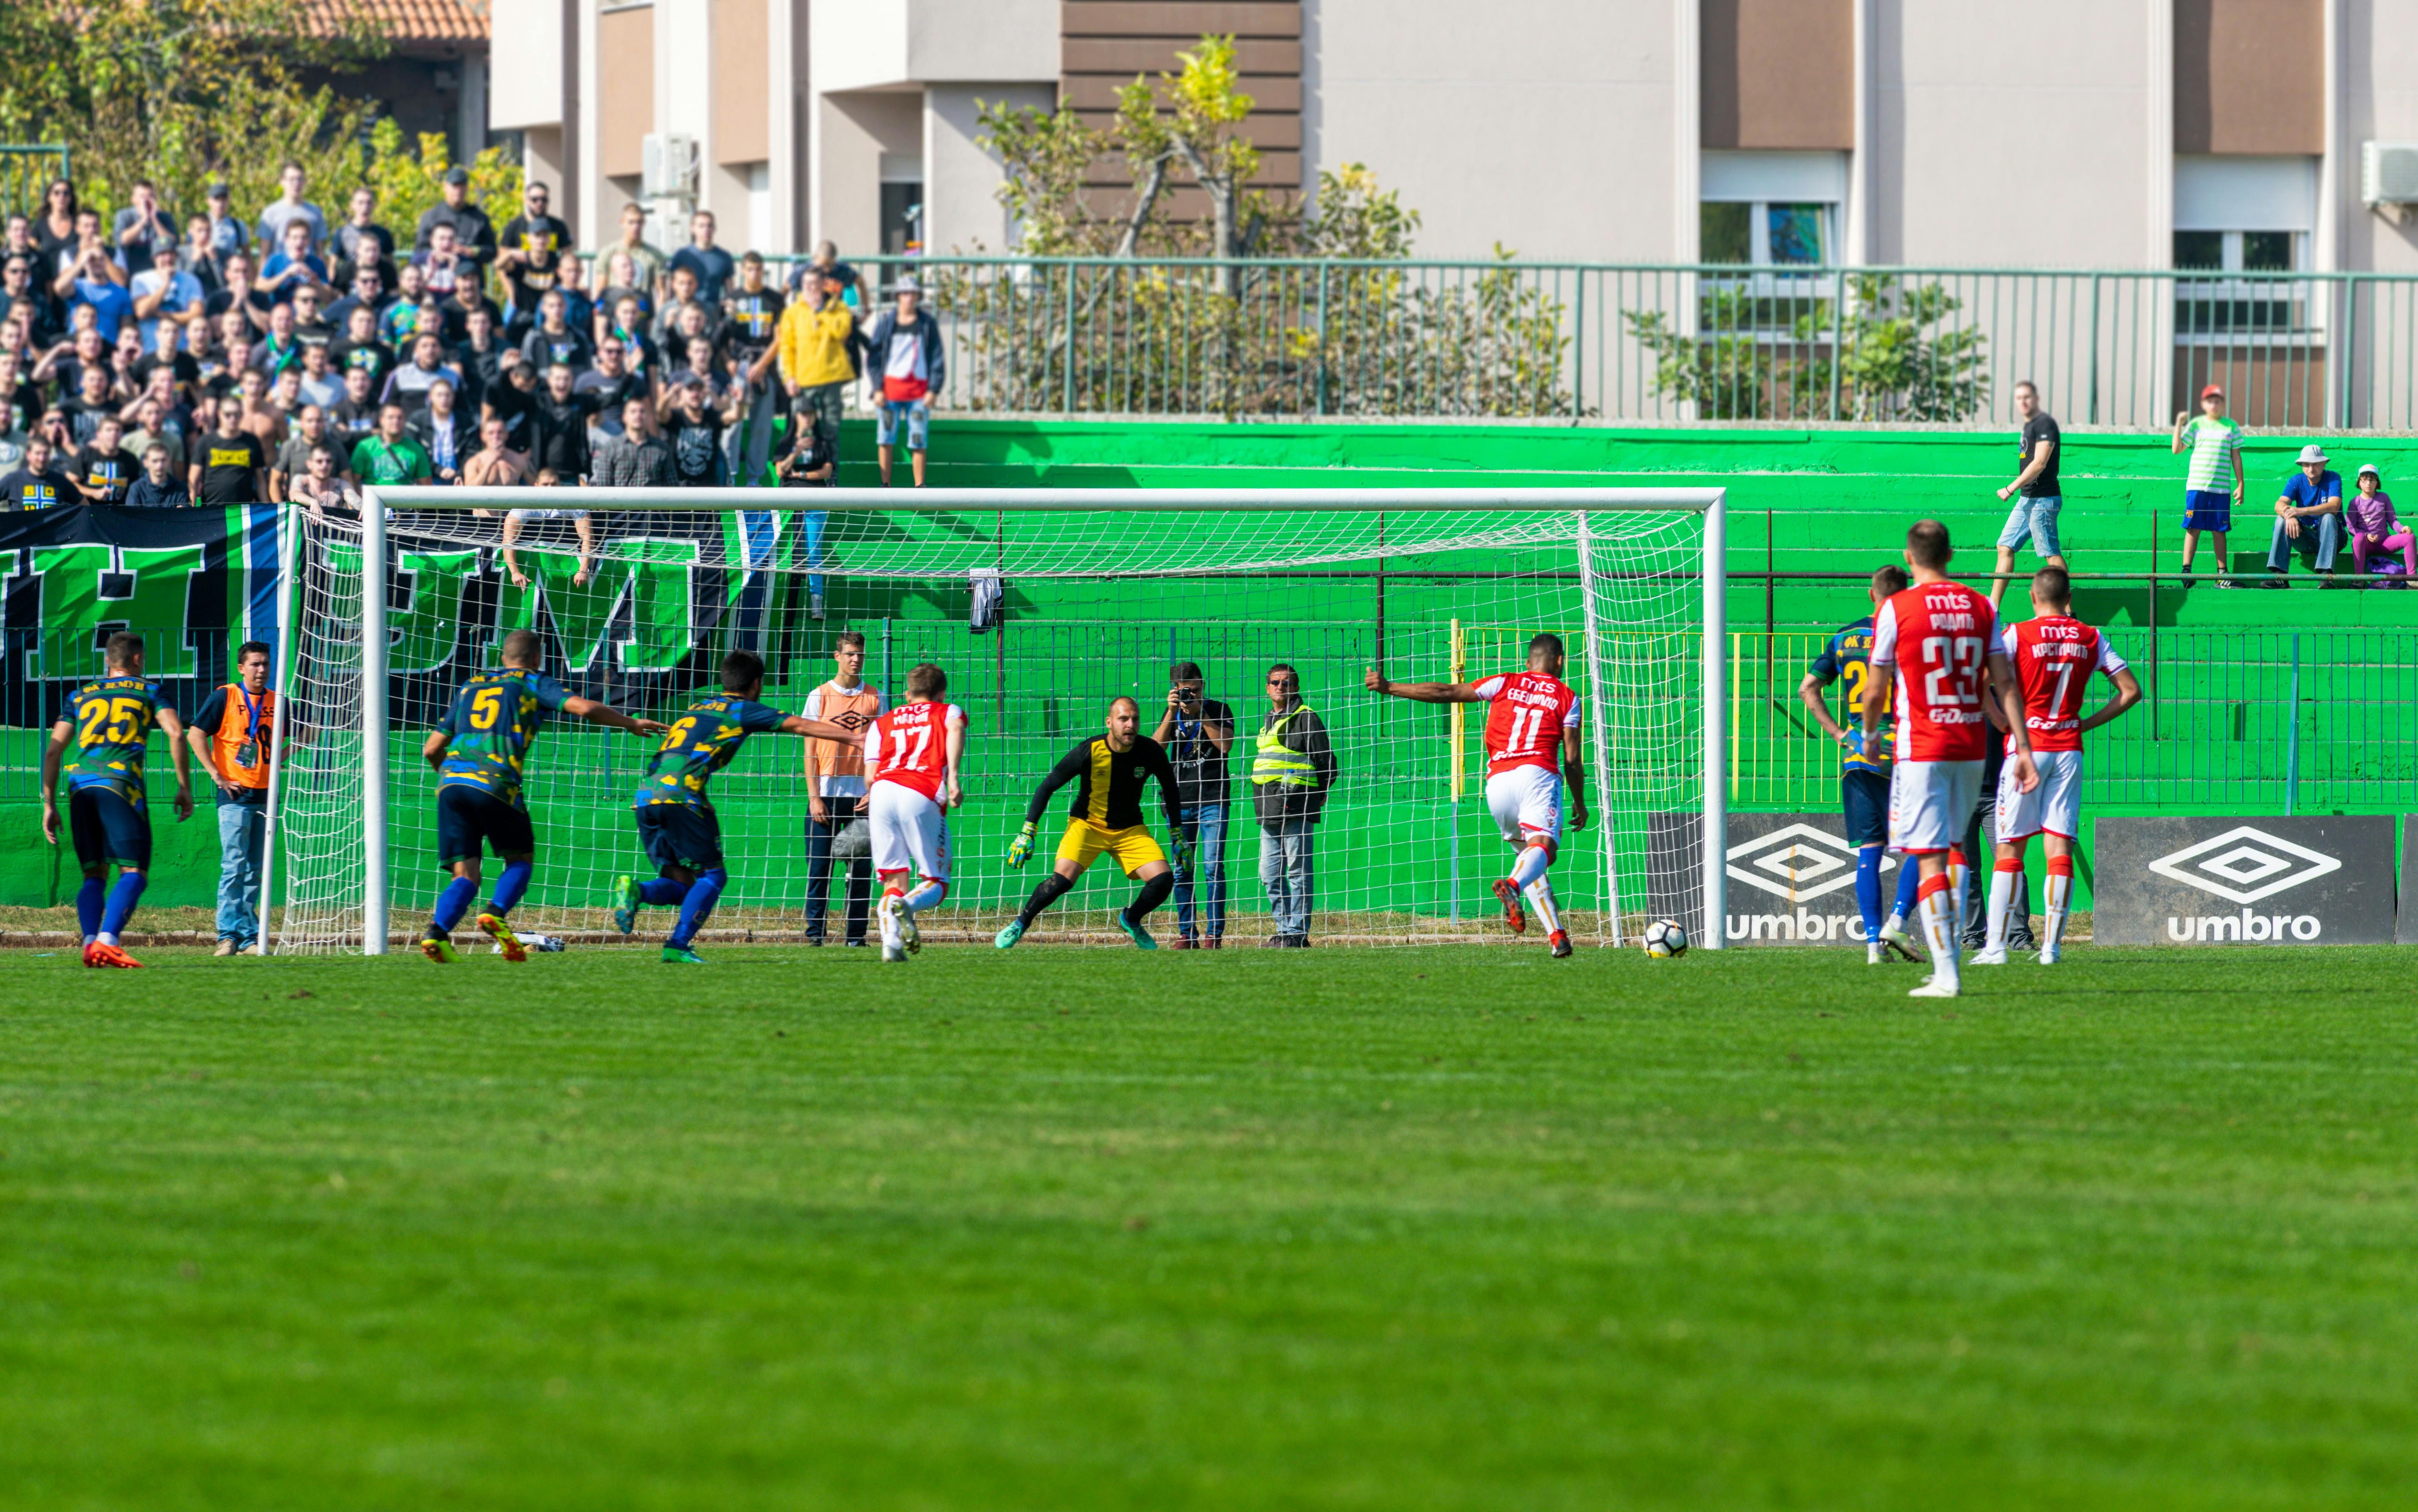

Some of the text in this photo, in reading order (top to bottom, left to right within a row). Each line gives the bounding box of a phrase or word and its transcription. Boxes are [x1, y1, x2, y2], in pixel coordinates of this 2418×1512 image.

[1924, 592, 1972, 610] mts
[2040, 624, 2079, 639] mts
[1521, 677, 1556, 693] mts
[1922, 636, 1984, 705] 23
[470, 687, 503, 729] 5
[893, 704, 931, 714] mts
[2047, 663, 2074, 719] 7
[79, 697, 143, 749] 25
[657, 716, 697, 752] 6
[1506, 706, 1544, 752] 11
[887, 725, 932, 770] 17
[1726, 907, 1870, 940] umbro
[2168, 908, 2321, 941] umbro
